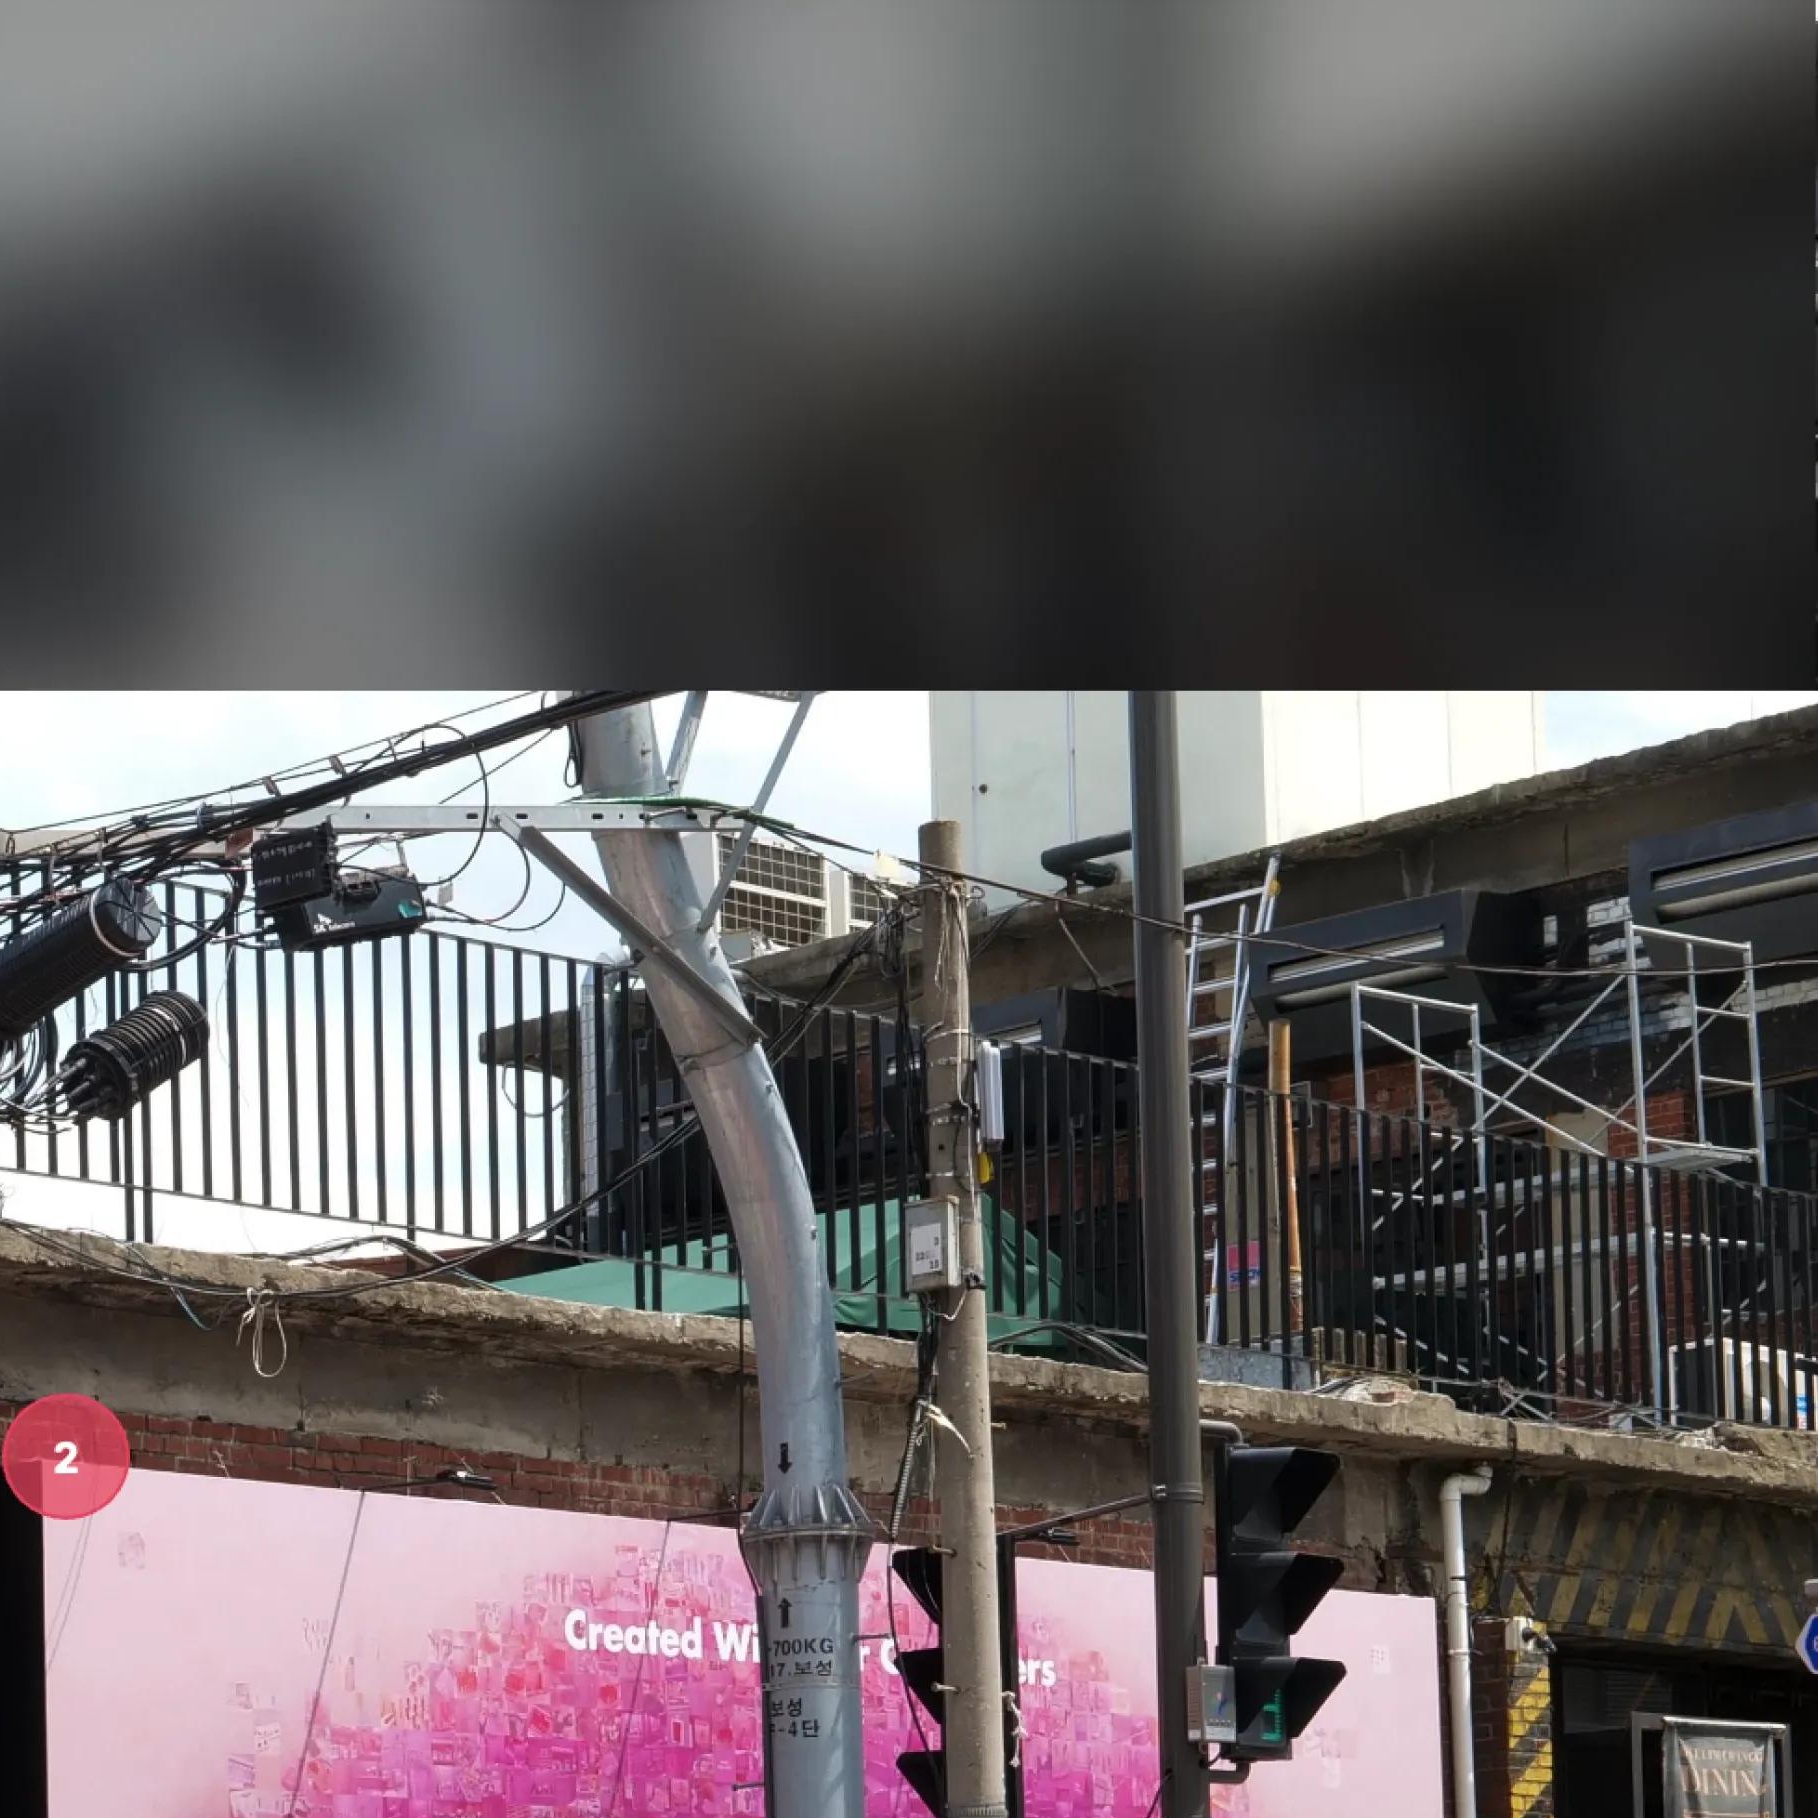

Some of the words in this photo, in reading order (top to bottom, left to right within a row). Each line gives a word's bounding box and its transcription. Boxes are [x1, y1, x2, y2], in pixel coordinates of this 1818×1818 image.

[564, 1608, 702, 1658] Created
[714, 1619, 760, 1662] Wi
[1681, 1767, 1771, 1797] DININ
